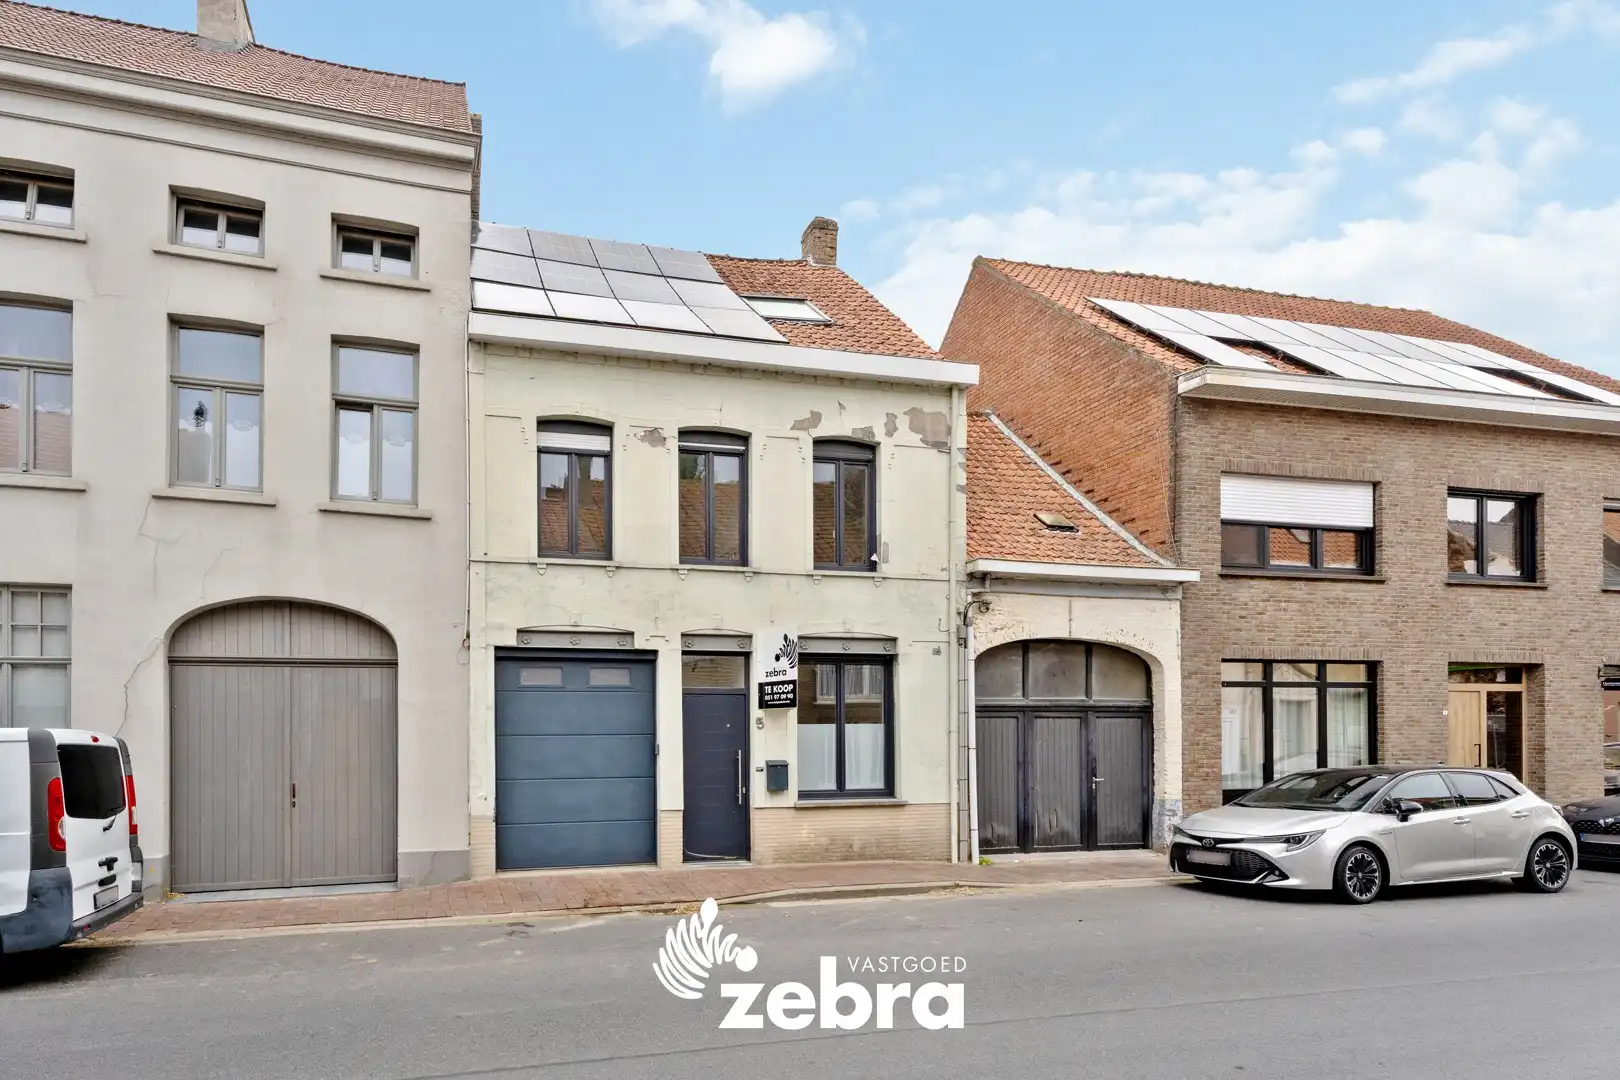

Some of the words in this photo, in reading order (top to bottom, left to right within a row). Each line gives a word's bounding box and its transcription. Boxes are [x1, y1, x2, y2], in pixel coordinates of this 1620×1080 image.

[765, 667, 787, 678] zebra
[764, 686, 772, 694] TE
[773, 684, 794, 693] KOOP
[756, 717, 764, 730] 5
